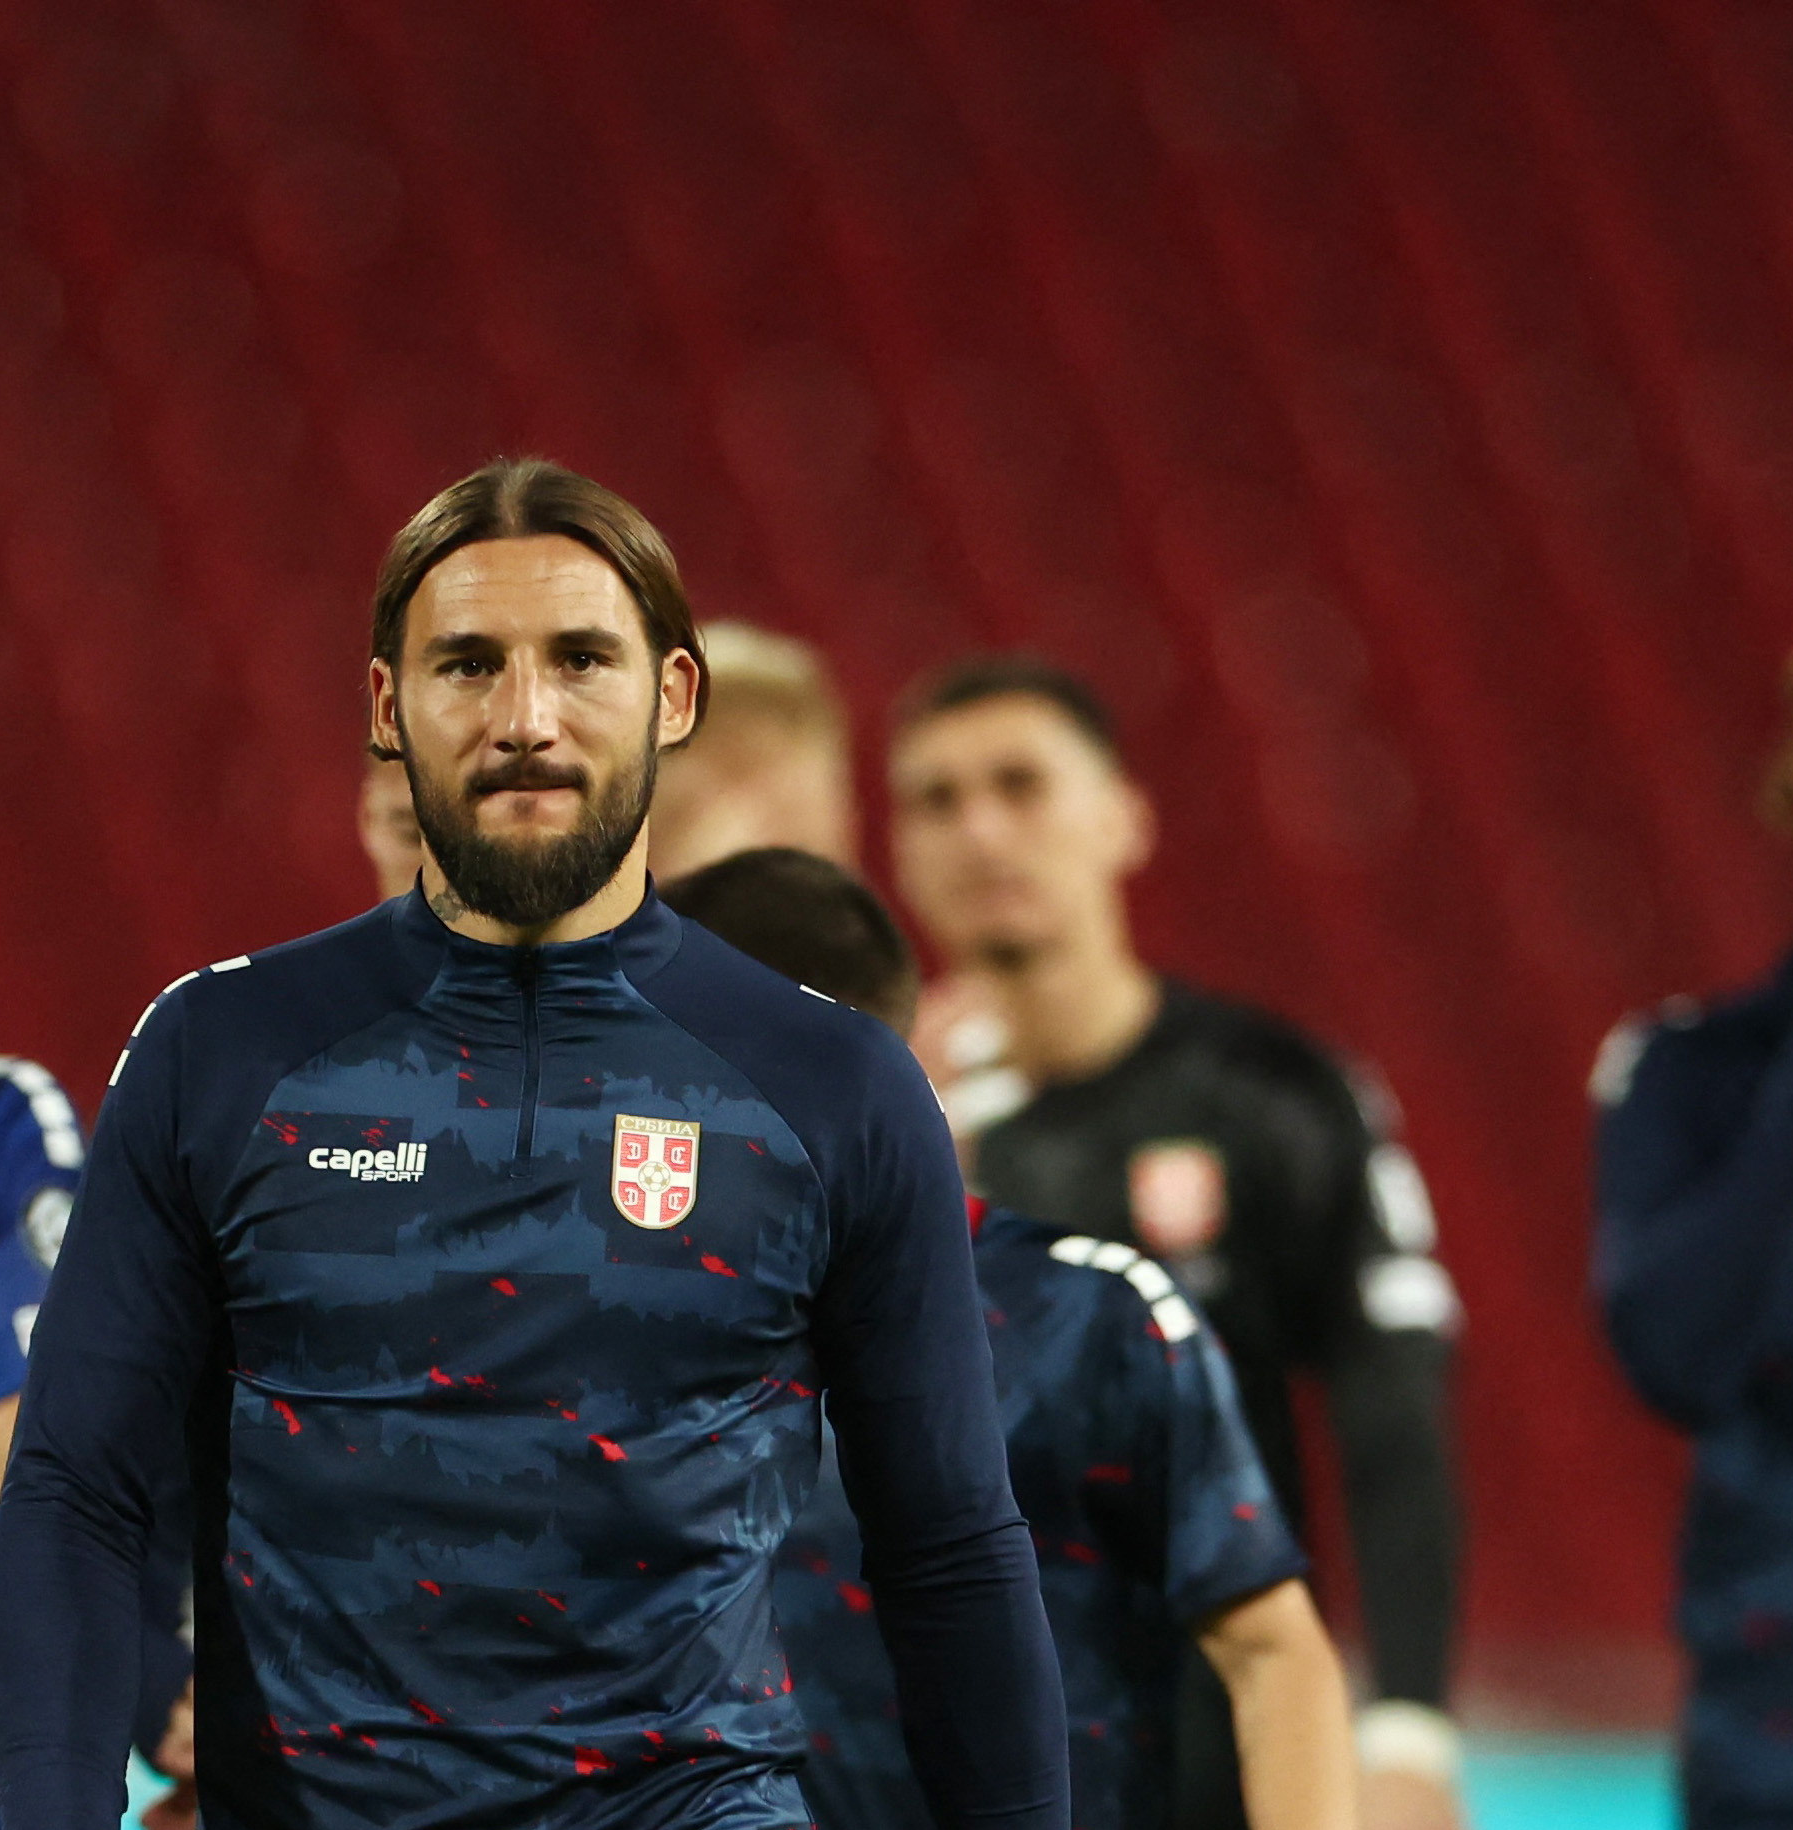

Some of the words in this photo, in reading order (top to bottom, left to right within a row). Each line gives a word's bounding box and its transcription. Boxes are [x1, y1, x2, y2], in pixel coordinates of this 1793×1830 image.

[620, 1117, 694, 1135] СРБИЈА
[308, 1142, 427, 1178] capelli
[360, 1169, 424, 1182] SPORT
